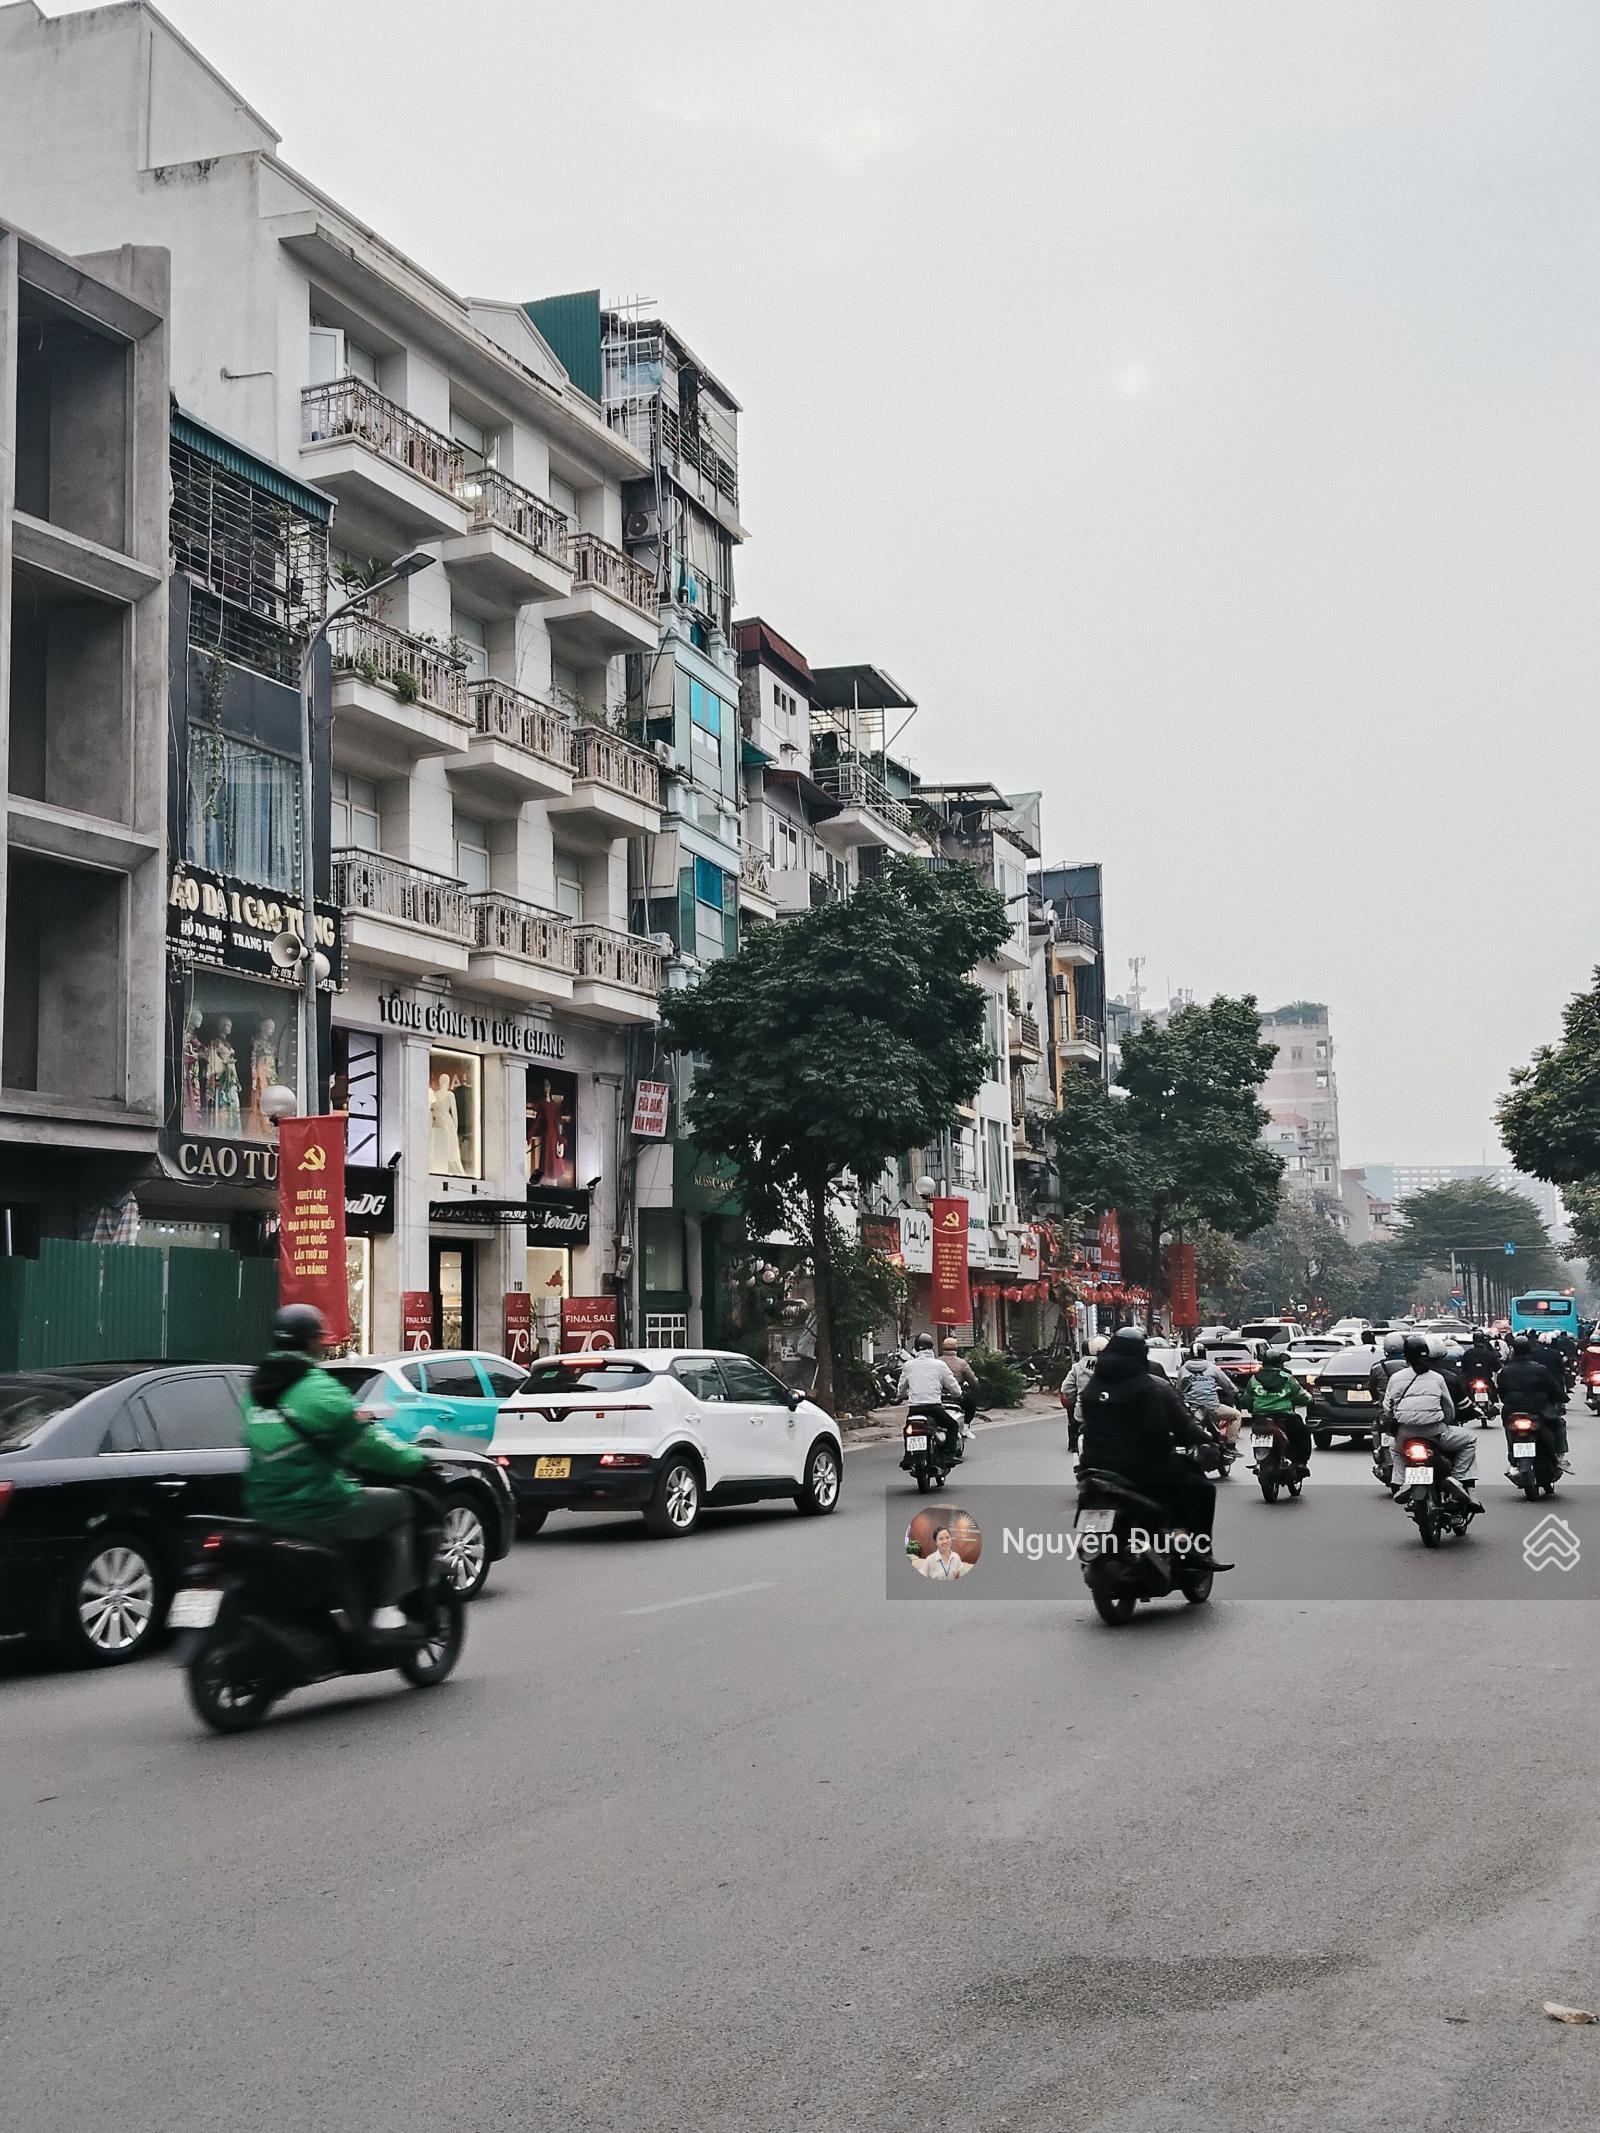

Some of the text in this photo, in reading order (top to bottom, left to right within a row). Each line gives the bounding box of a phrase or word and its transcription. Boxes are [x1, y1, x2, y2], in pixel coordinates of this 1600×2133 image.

[242, 895, 283, 933] CAO
[194, 922, 208, 940] DẠ
[208, 925, 223, 944] HỘI
[232, 933, 263, 951] TRANG
[427, 1003, 468, 1038] CÔNG
[472, 1016, 489, 1042] TY
[525, 1029, 566, 1058] GIANG
[179, 1143, 280, 1180] CAO TÙ
[314, 1188, 326, 1201] LIỆT
[310, 1232, 327, 1245] QUỐC
[318, 1250, 329, 1259] XIV
[405, 1316, 432, 1324] FINAL SALE
[507, 1315, 520, 1323] FINAL
[565, 1314, 616, 1323] FINAL SALE
